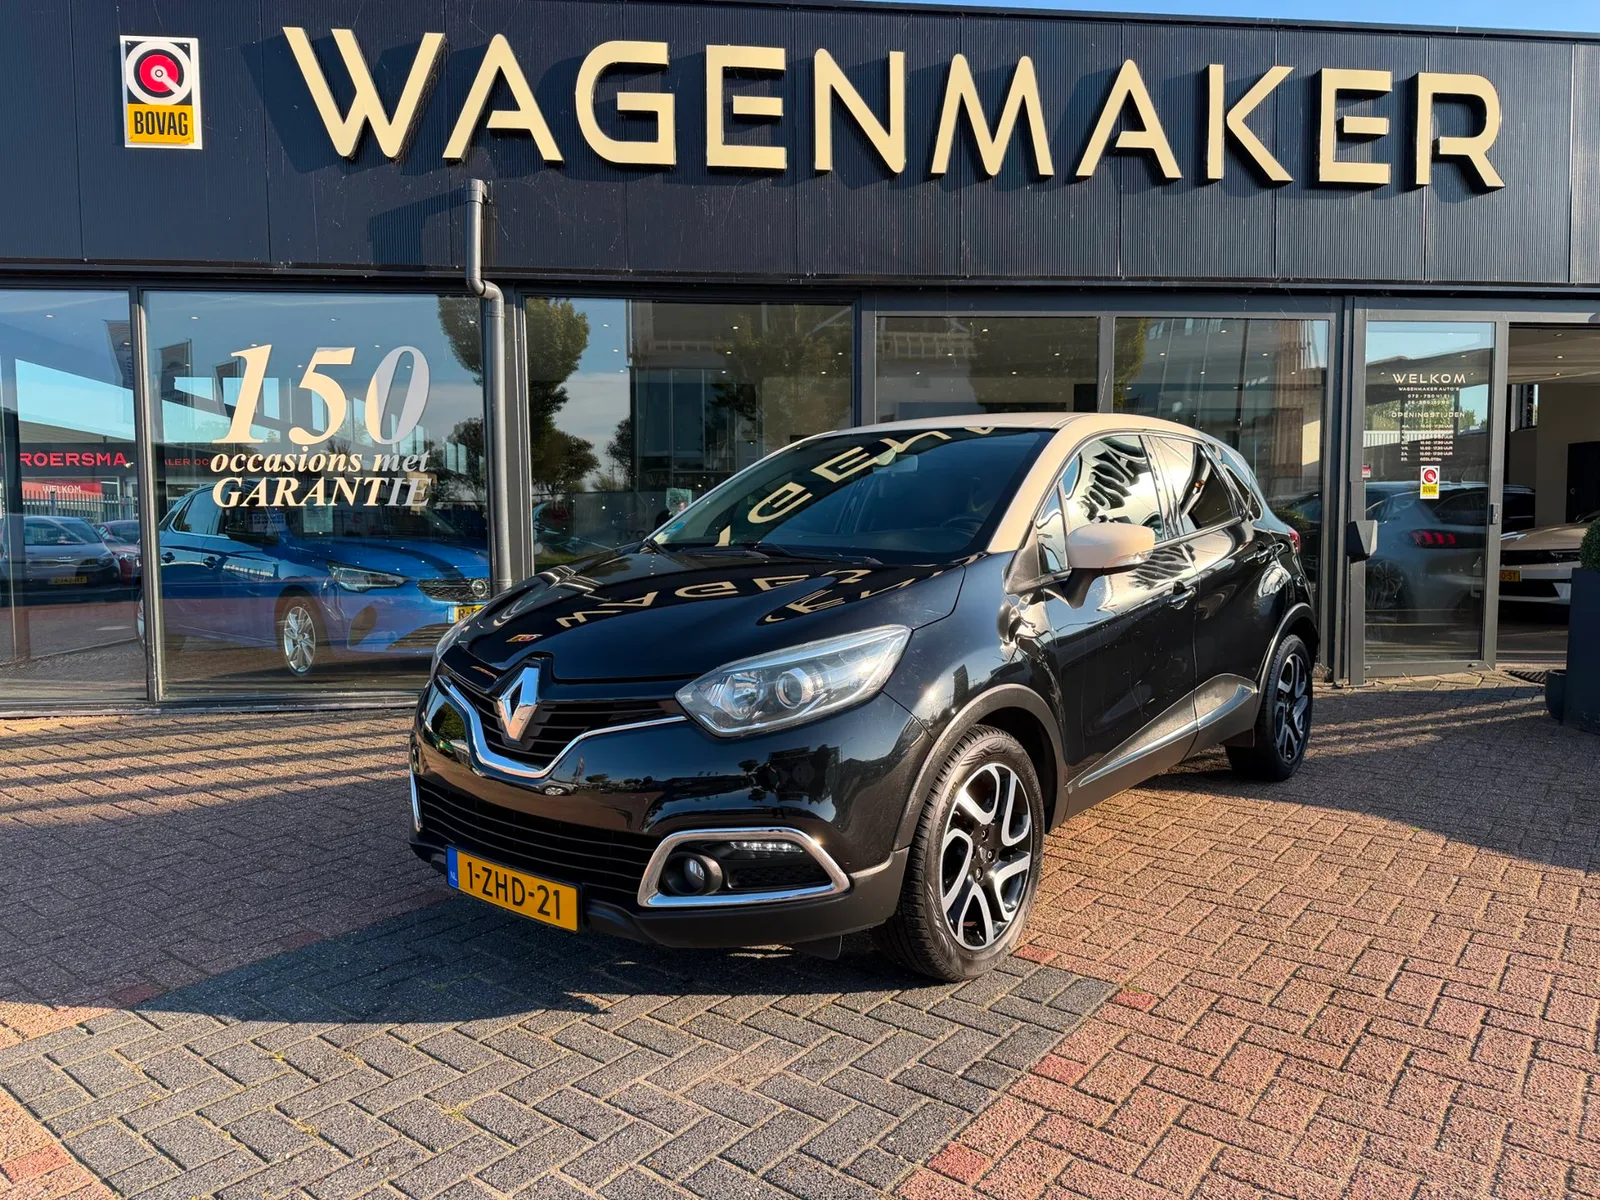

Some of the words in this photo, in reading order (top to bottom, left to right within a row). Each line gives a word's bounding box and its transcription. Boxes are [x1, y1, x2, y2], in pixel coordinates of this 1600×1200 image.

[282, 26, 1505, 189] WAGENMAKER
[133, 110, 189, 136] BOVAG
[1392, 373, 1466, 384] WELKOM
[211, 344, 430, 445] 150
[210, 446, 363, 473] occasions
[374, 451, 430, 473] met
[42, 485, 81, 493] WELKOM
[211, 476, 433, 508] GARANTIE
[467, 861, 560, 920] 1-ZHD-21
